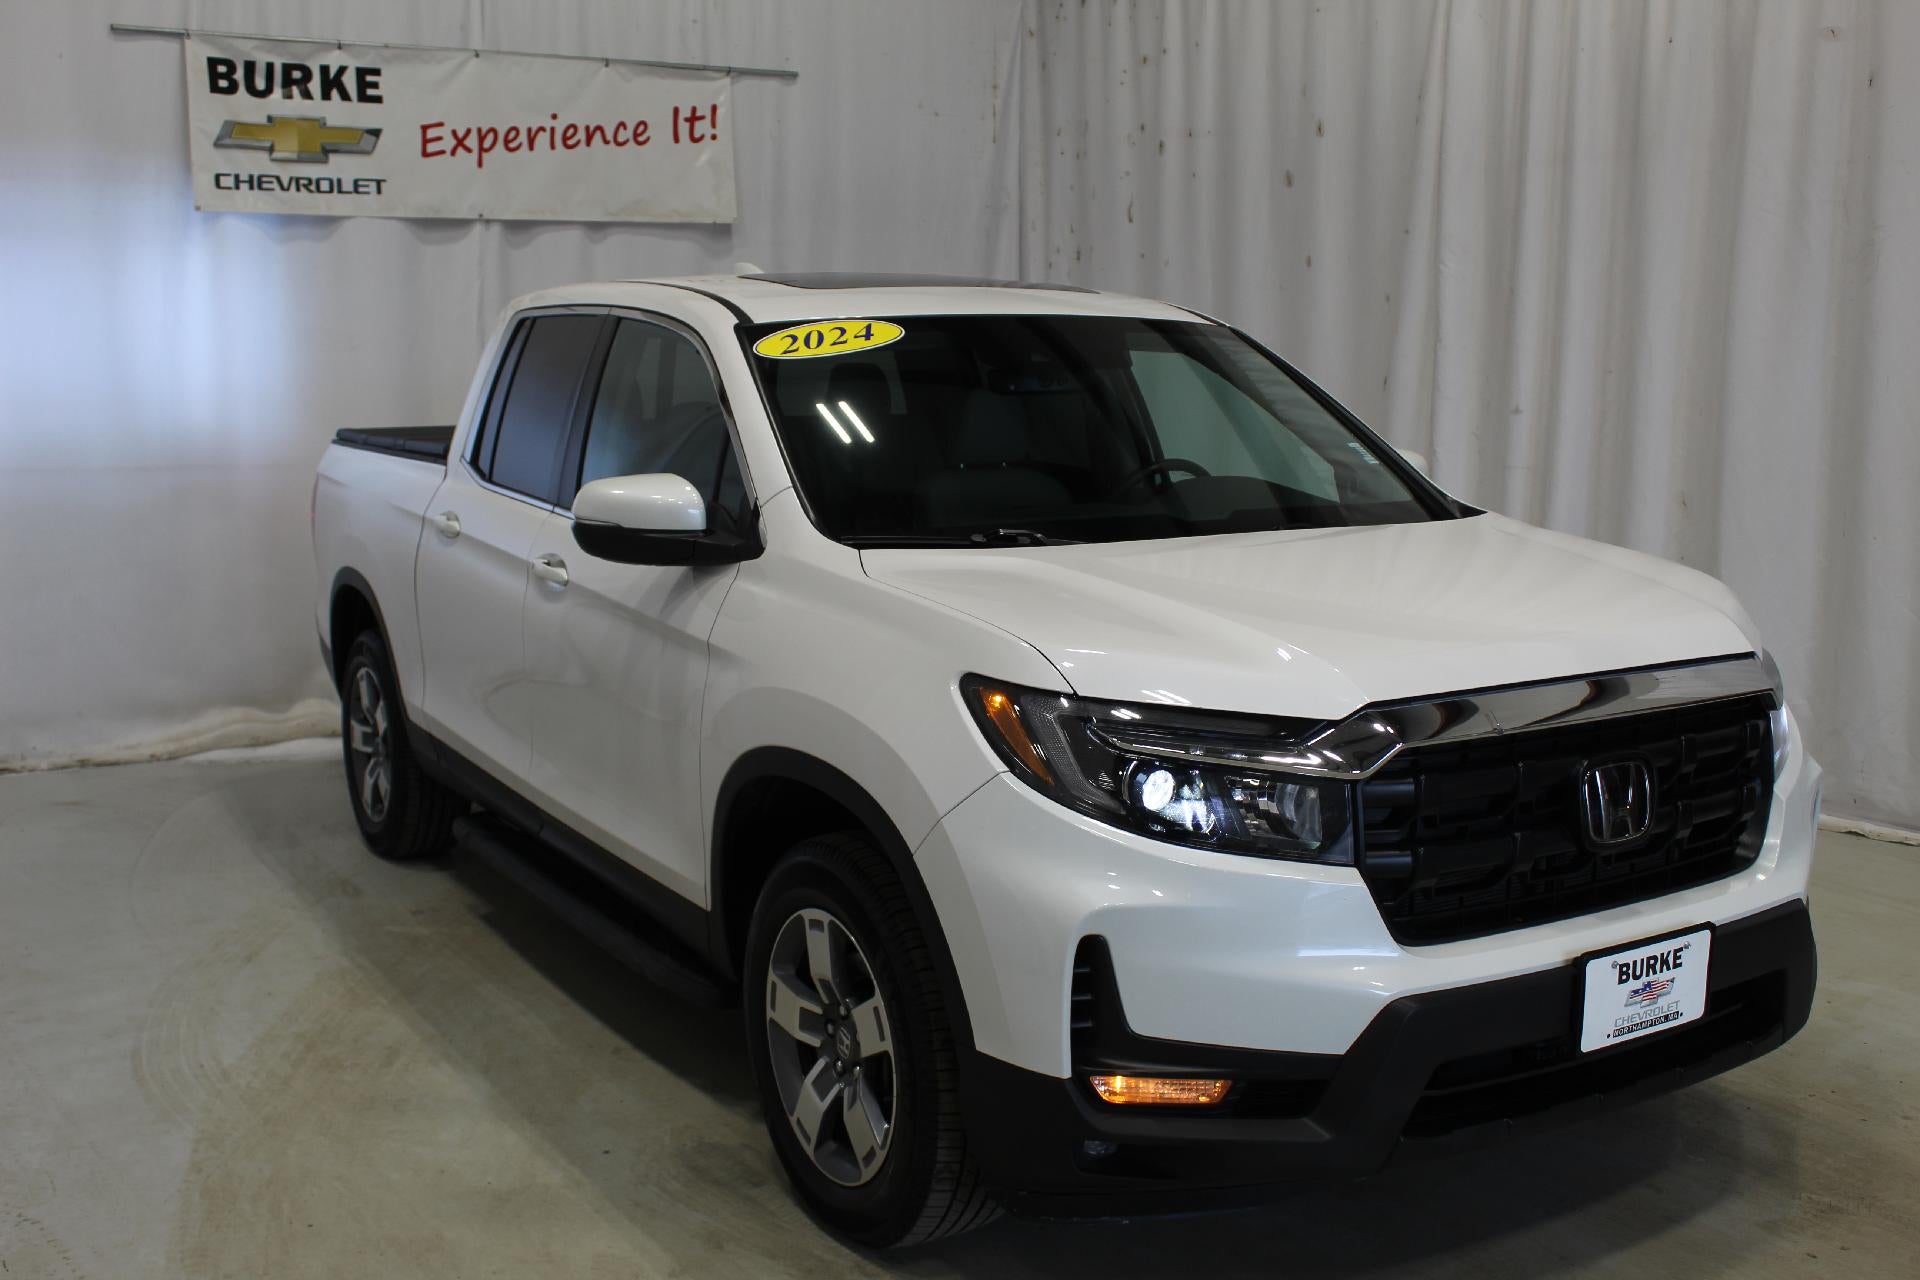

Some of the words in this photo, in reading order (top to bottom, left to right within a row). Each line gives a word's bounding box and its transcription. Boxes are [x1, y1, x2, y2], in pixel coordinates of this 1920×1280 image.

[206, 56, 384, 105] BURKE
[420, 113, 651, 169] Experience
[672, 103, 718, 145] It!
[213, 172, 387, 195] CHEVROLET
[779, 323, 875, 355] 2024
[1617, 946, 1684, 986] BURKE
[1614, 1000, 1681, 1029] CHEVROLET
